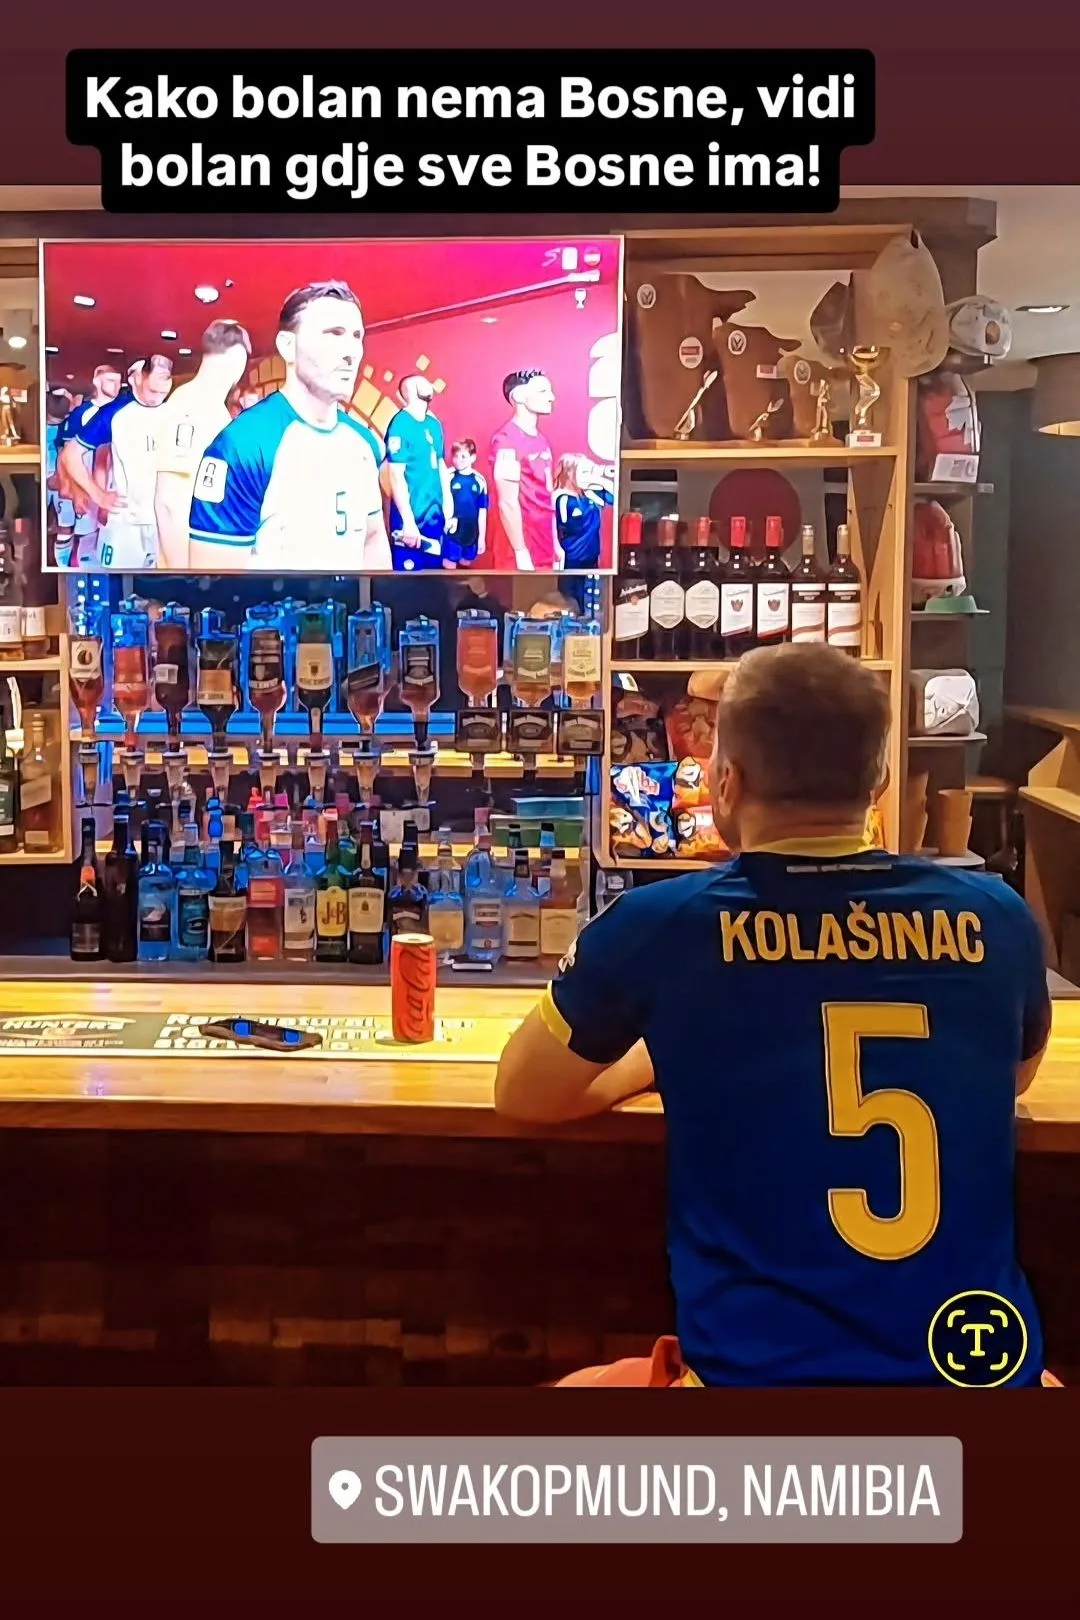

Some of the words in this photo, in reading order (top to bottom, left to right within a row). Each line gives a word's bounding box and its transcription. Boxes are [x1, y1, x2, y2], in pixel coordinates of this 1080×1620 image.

[335, 491, 348, 536] 5
[321, 901, 346, 926] J&B
[719, 901, 986, 963] KOLAŠINAC
[821, 1001, 942, 1261] 5
